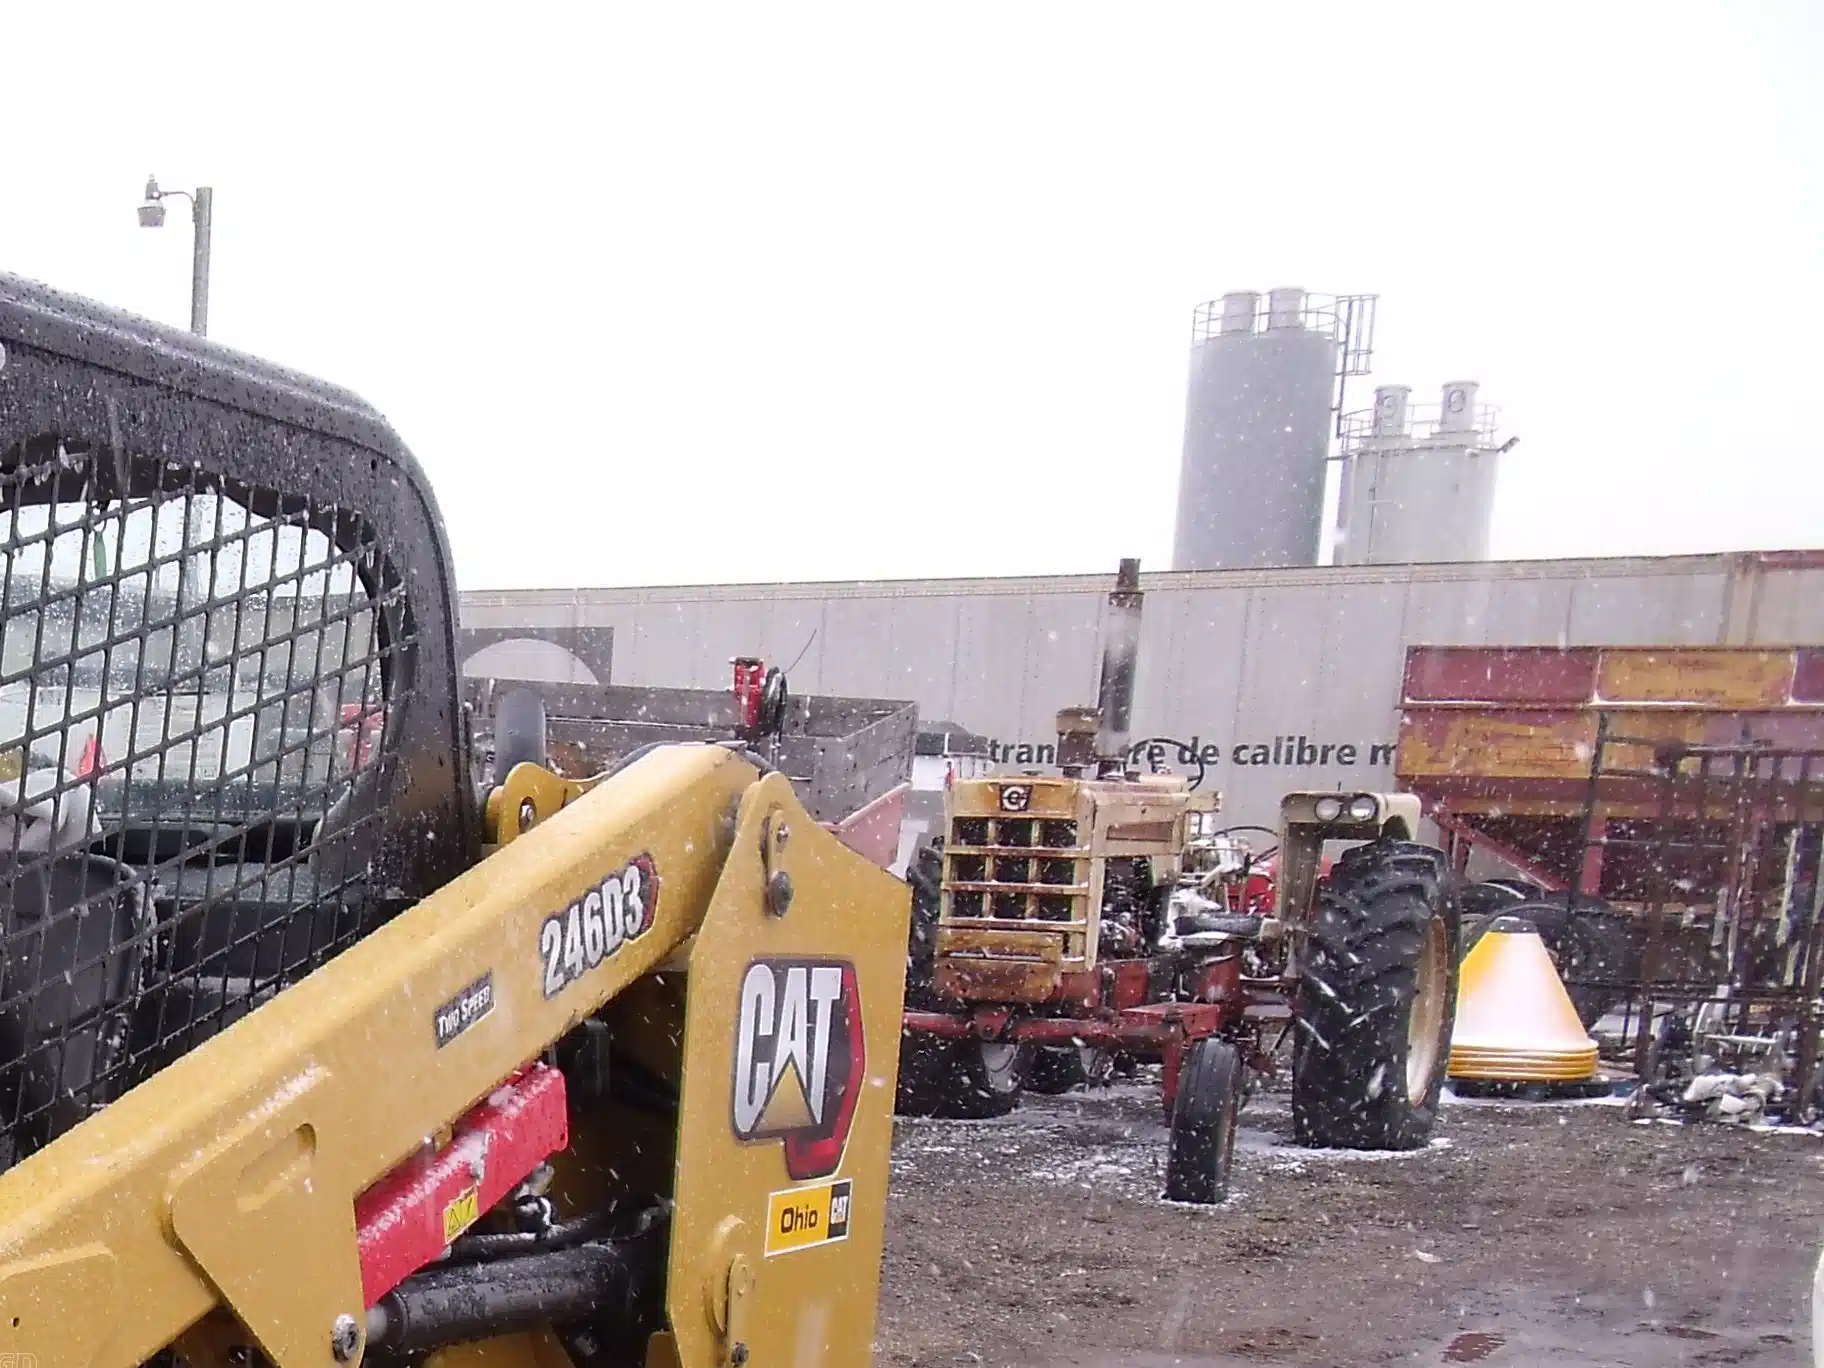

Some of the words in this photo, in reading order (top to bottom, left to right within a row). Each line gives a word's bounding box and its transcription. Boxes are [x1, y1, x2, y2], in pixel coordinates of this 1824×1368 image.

[1178, 736, 1219, 765] de
[1232, 736, 1357, 766] calibre
[541, 865, 644, 995] 246D3
[734, 963, 843, 1133] CAT
[780, 1204, 819, 1234] Ohio
[830, 1195, 849, 1225] CAT
